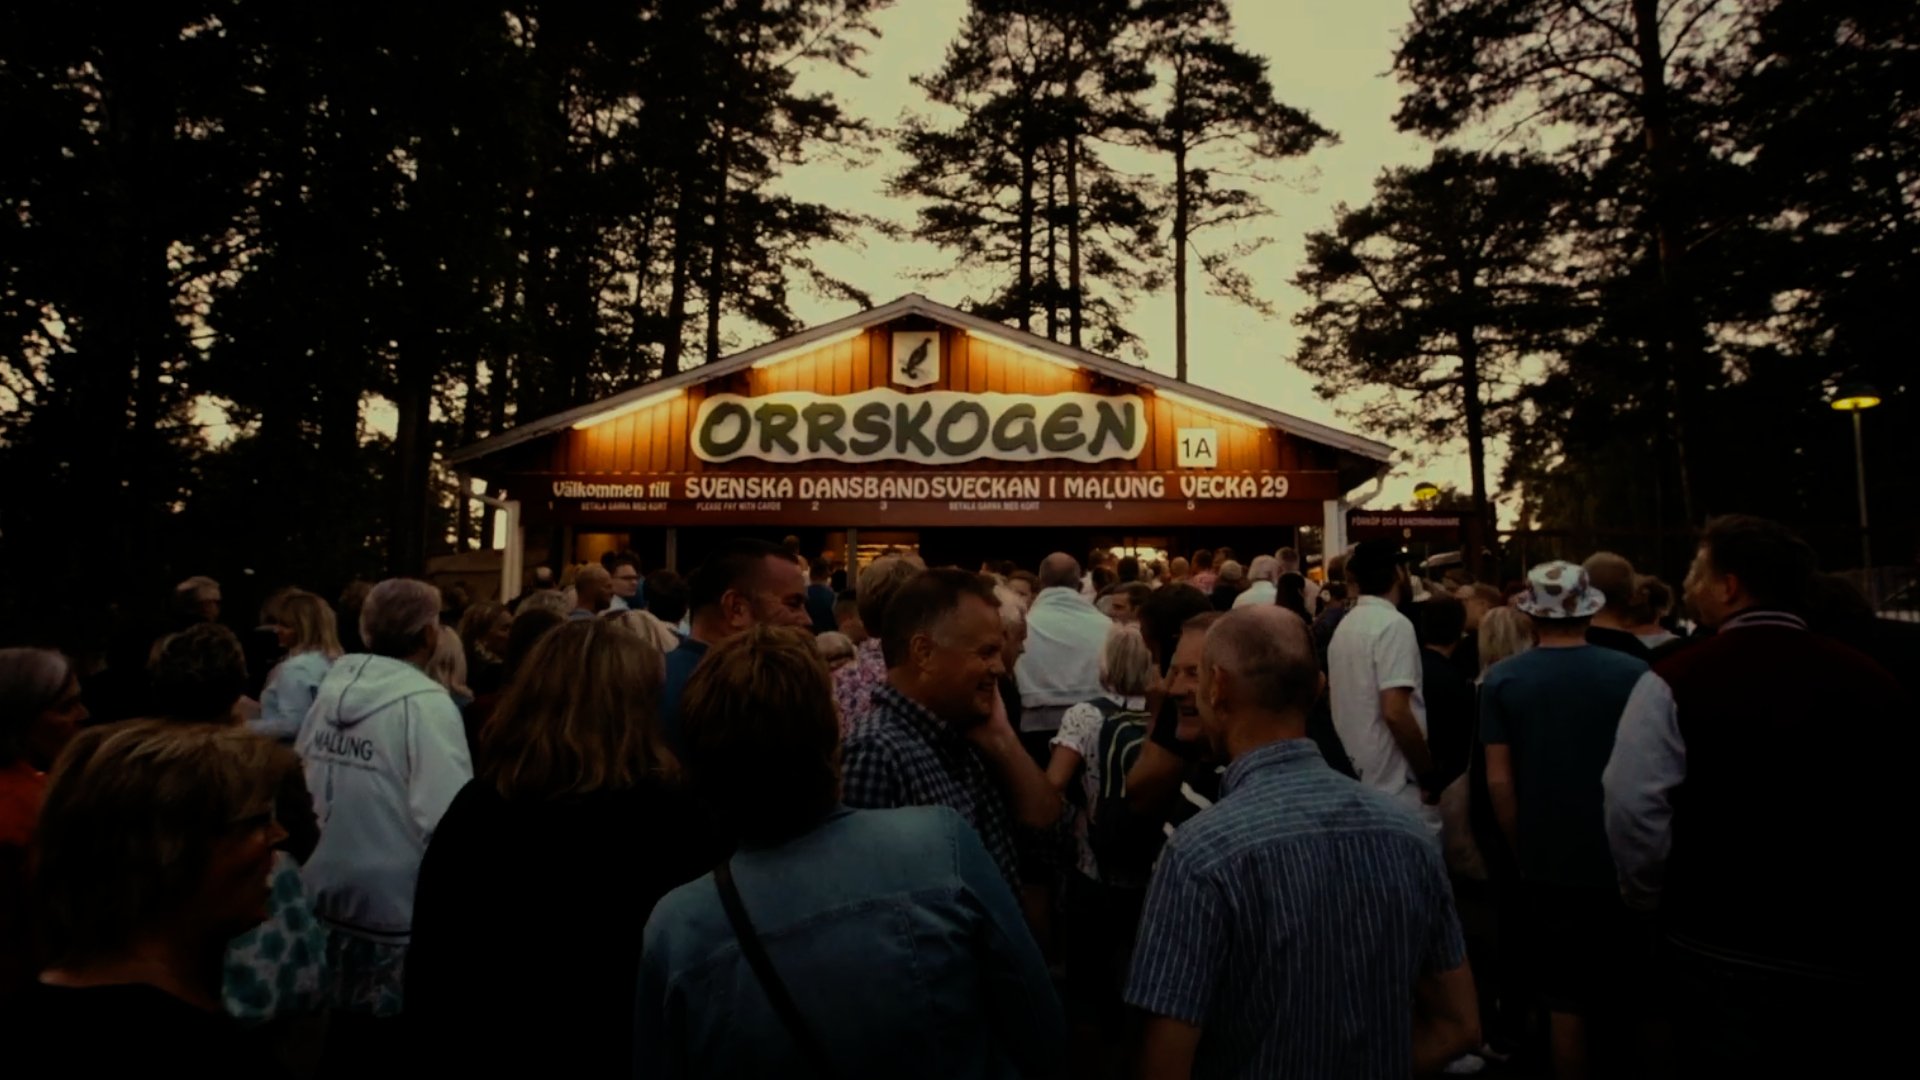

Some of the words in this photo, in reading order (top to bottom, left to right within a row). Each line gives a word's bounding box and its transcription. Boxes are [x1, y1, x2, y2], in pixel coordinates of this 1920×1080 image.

[700, 401, 1135, 457] ORRSKOGEN
[1181, 437, 1212, 460] 1A
[552, 480, 644, 498] Välkommen
[648, 481, 671, 498] till
[685, 476, 794, 499] SVENSKA
[1049, 476, 1056, 499] I
[1064, 476, 1165, 499] MALUNG
[1179, 475, 1258, 499] VECKA
[1260, 475, 1289, 499] 29
[696, 501, 722, 511] PLEASE
[811, 500, 820, 511] 2
[880, 500, 888, 511] 3
[1104, 500, 1113, 511] 4
